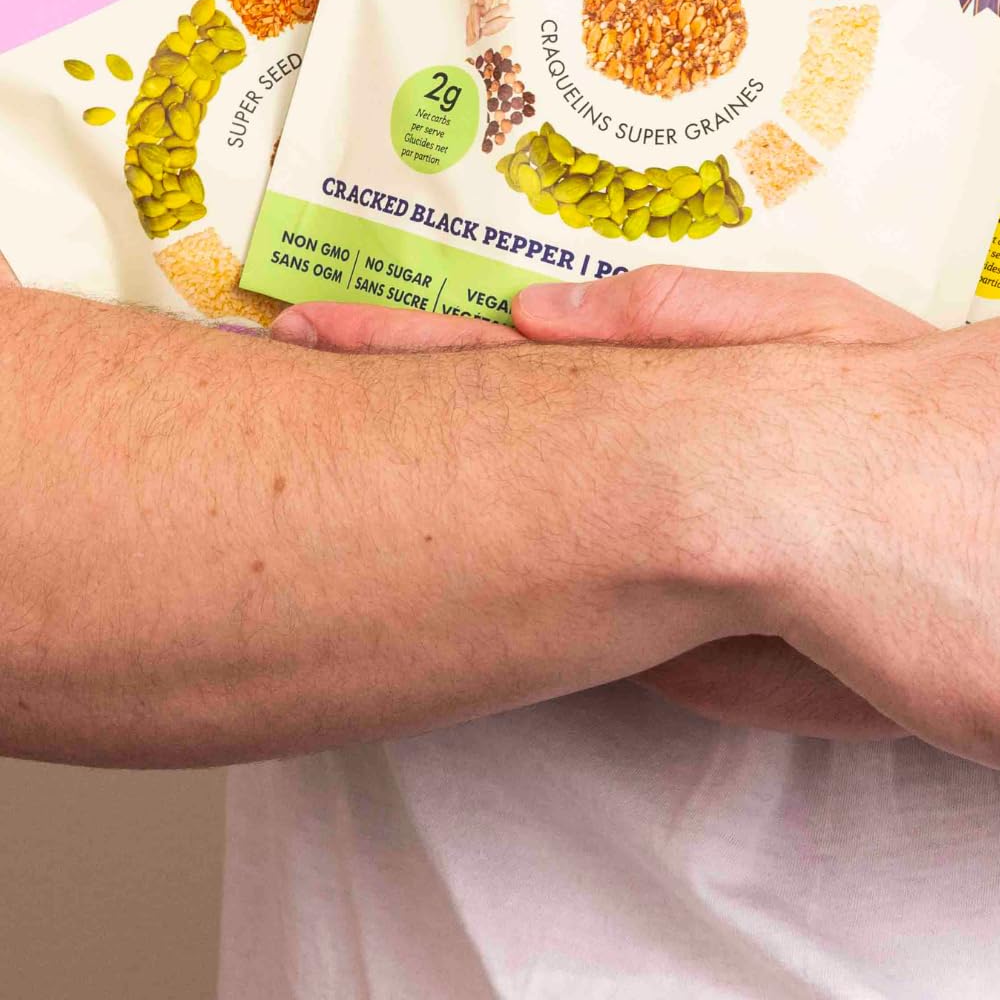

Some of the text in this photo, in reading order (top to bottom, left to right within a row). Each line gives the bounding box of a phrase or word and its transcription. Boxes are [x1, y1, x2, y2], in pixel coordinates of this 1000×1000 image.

[424, 72, 462, 112] 2g
[540, 19, 764, 145] CRAQUELINS SUPER GRAINES
[227, 53, 303, 148] SUPER SEED
[410, 122, 445, 138] per serve
[415, 108, 451, 126] Net carbs
[401, 147, 414, 157] par
[404, 133, 448, 154] Glucides net
[322, 177, 409, 217] CRACKED
[410, 203, 480, 241] BLACK
[482, 226, 576, 270] PEPPER
[282, 230, 350, 262] NON GMO
[271, 251, 343, 284] SANS OGM
[365, 256, 432, 288] NO SUGAR
[355, 277, 429, 311] SANS SUCRE
[467, 288, 512, 315] VEGA
